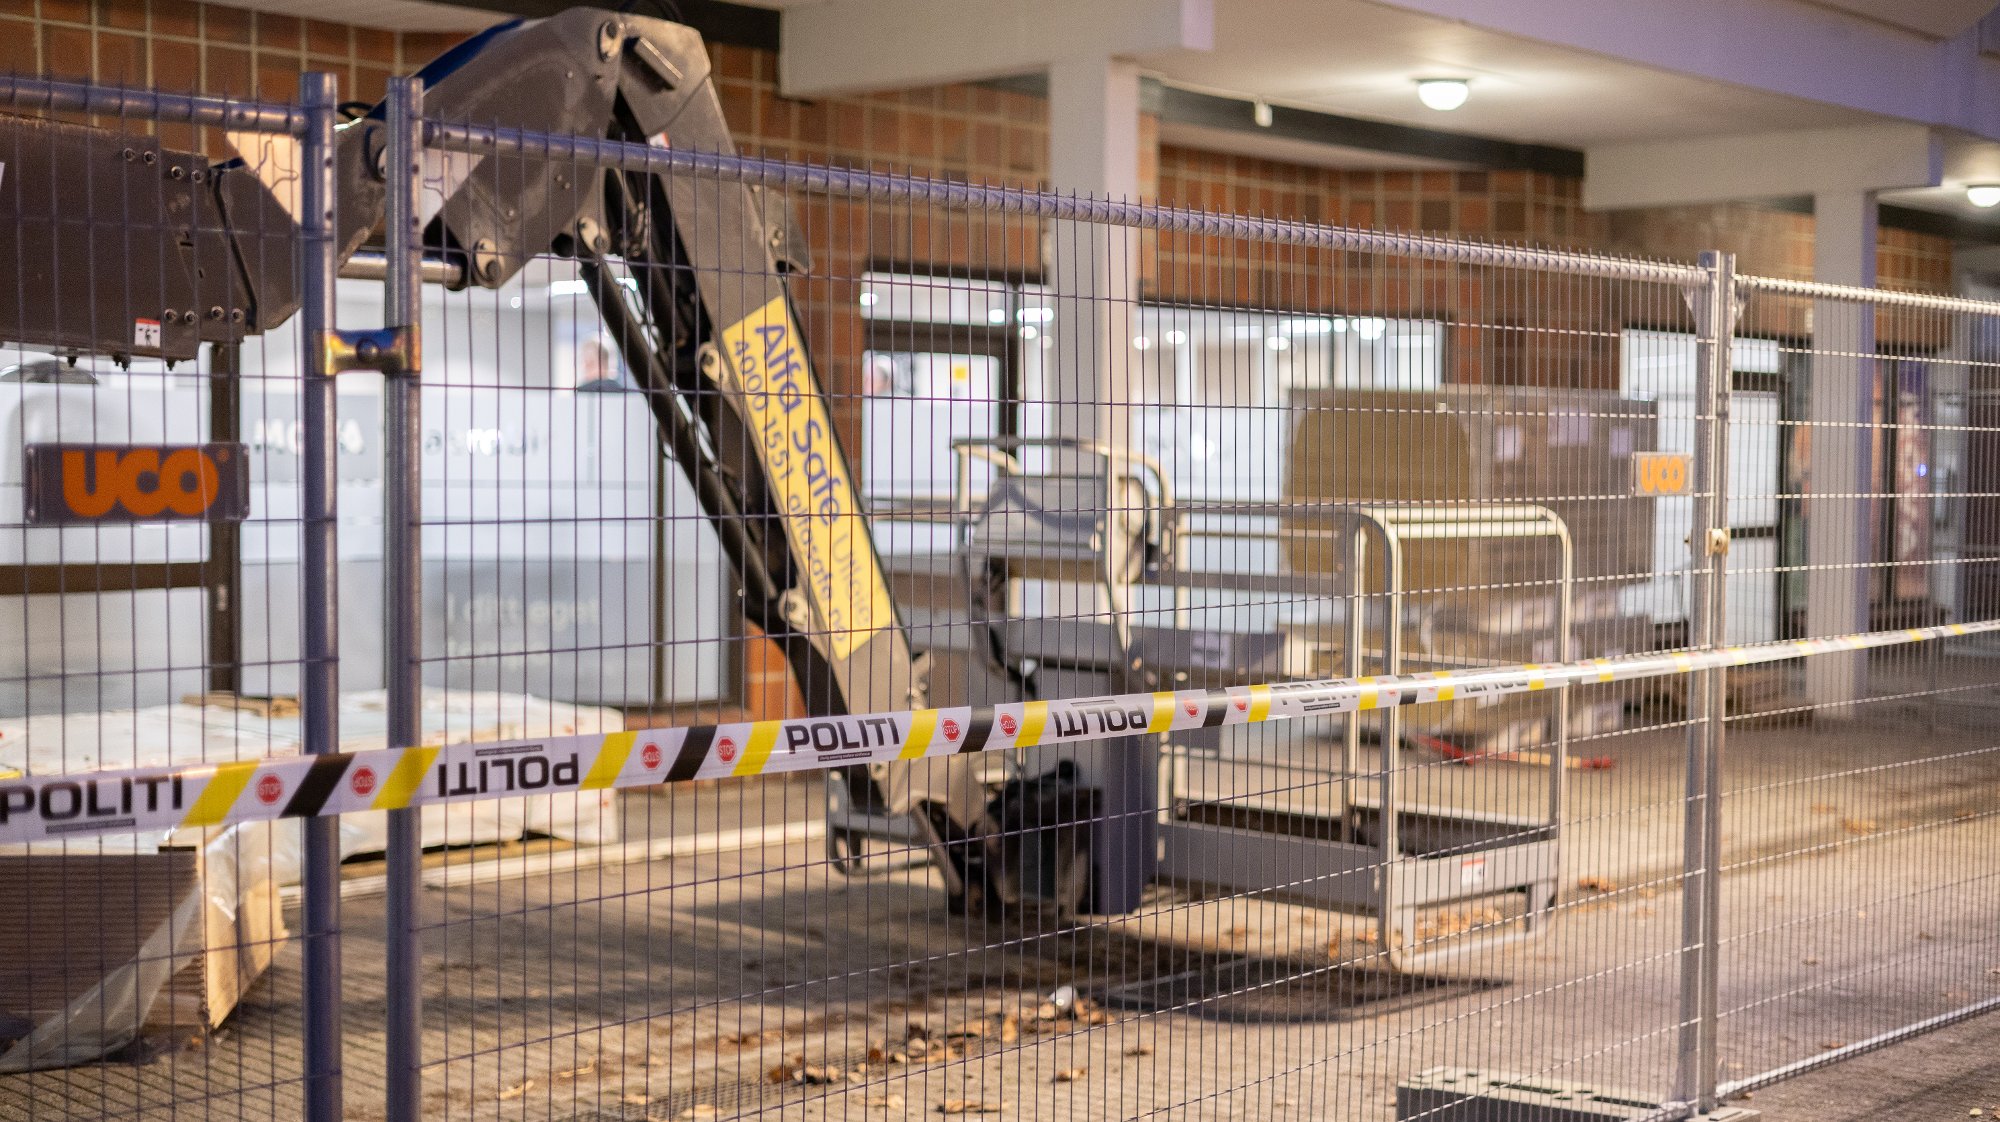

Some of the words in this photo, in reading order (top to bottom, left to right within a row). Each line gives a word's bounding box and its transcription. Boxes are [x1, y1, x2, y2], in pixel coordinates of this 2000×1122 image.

[754, 324, 802, 414] Alfa
[792, 418, 841, 527] Safe
[62, 448, 220, 517] UCO
[734, 340, 769, 412] 4000
[761, 417, 794, 480] 1551
[788, 493, 847, 641] alfasafeno
[1641, 455, 1686, 493] UCO
[785, 717, 900, 755] POLITI
[943, 724, 959, 735] STOP
[1053, 705, 1148, 738] POLITI
[718, 744, 735, 756] STOP
[258, 784, 281, 796] STOP
[438, 752, 579, 798] POLITI
[0, 773, 183, 824] POLITI
